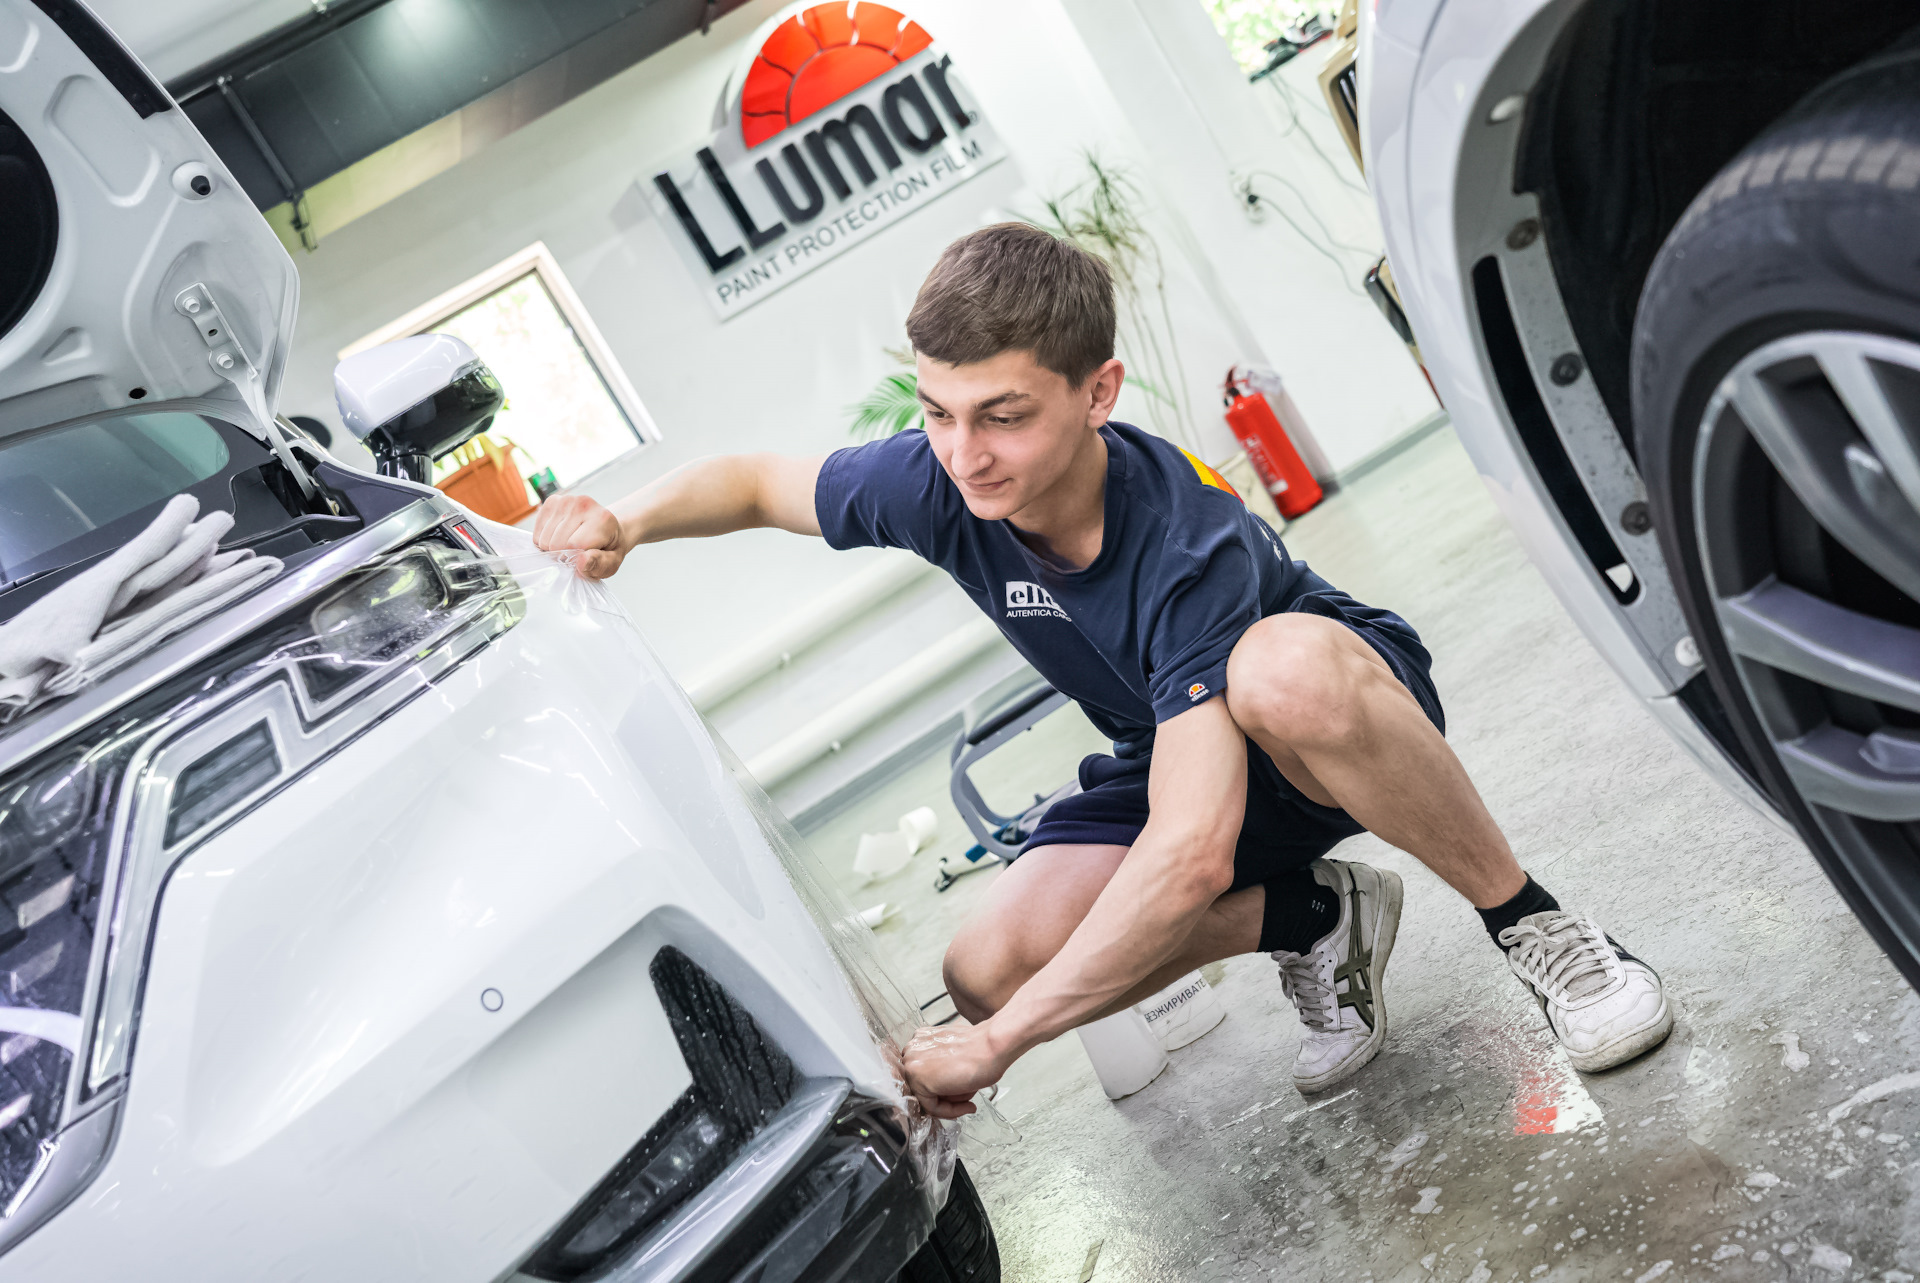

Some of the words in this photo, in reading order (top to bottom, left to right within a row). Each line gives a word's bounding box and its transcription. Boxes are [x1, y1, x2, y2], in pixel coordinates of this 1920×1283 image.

[715, 256, 785, 305] PAINT
[785, 172, 930, 266] PROTECTION
[930, 140, 983, 181] FILM
[1006, 609, 1052, 618] AUTENTICA
